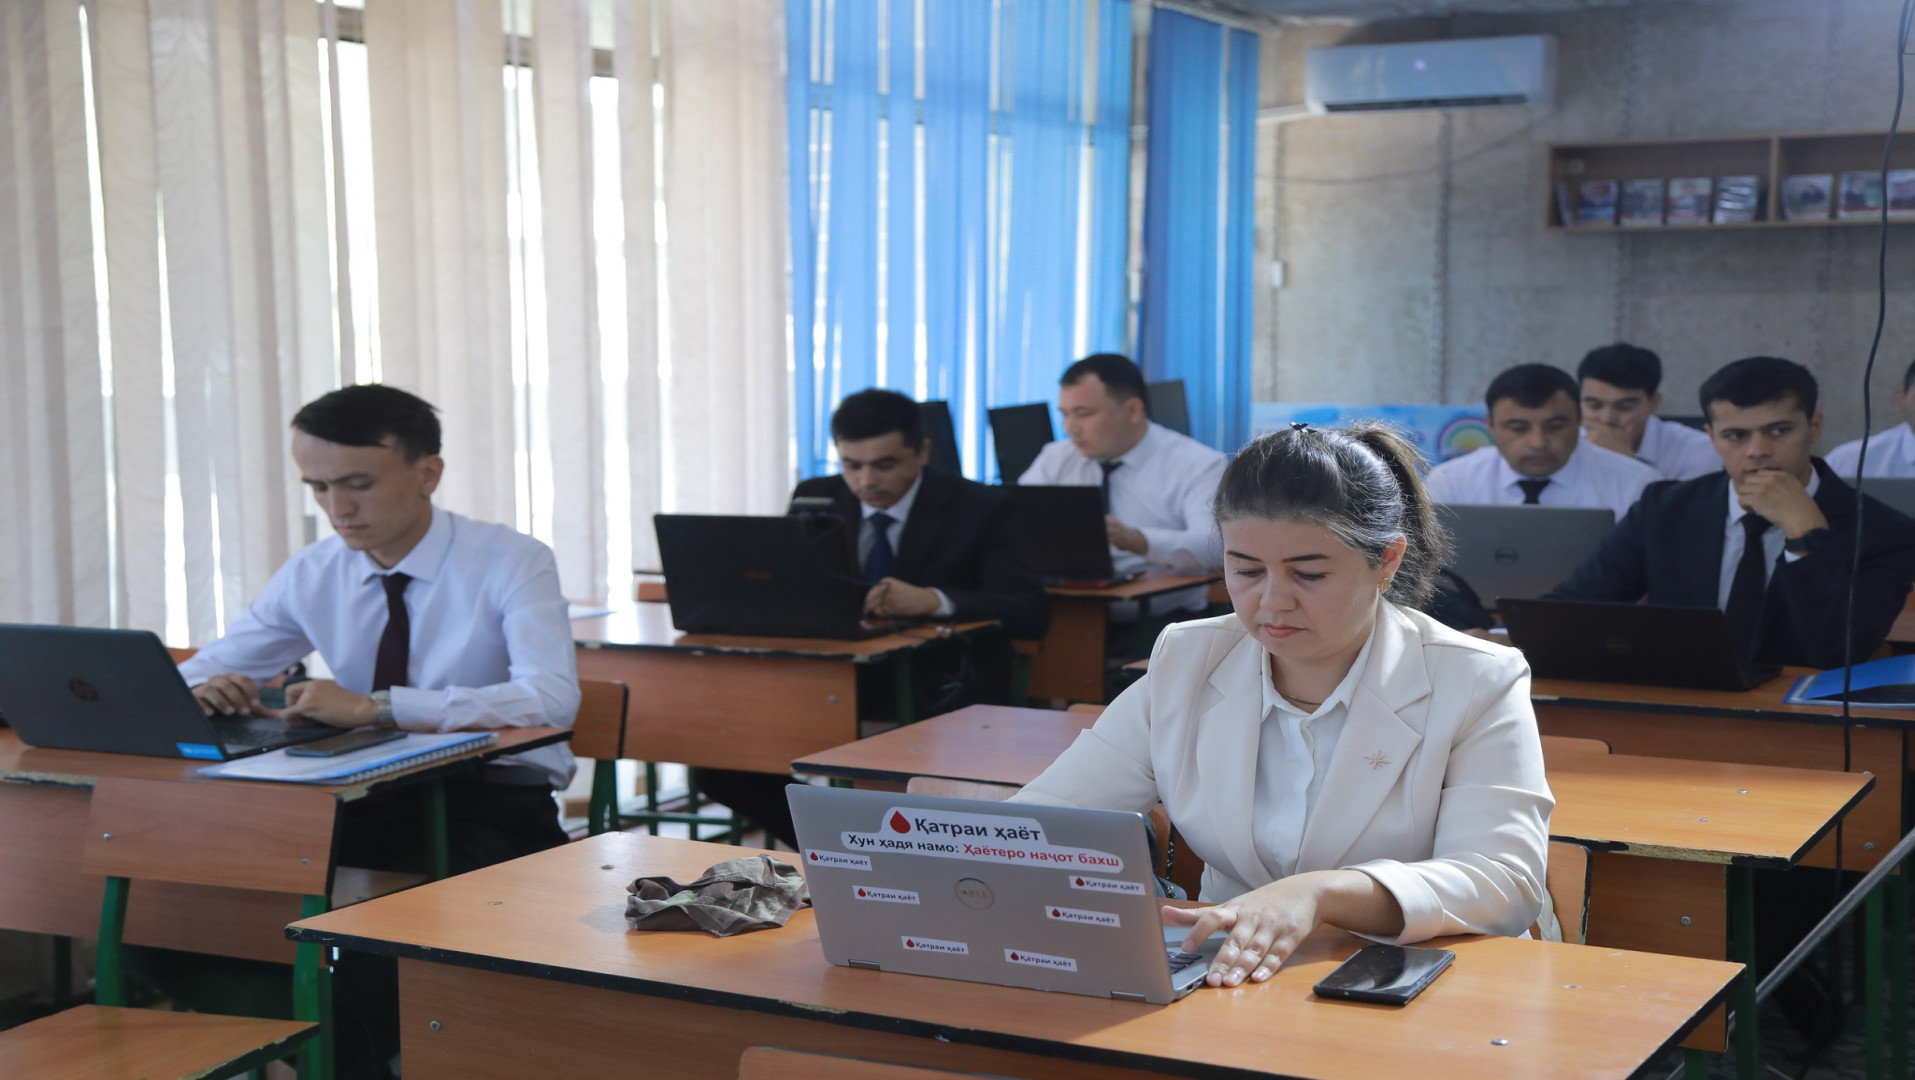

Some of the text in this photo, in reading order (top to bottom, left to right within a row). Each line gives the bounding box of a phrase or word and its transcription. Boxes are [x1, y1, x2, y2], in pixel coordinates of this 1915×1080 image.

[914, 818, 1041, 841] Қатраи ҳаёт
[848, 834, 875, 847] Хун
[879, 839, 913, 850] ҳадя
[917, 843, 959, 853] намо:
[963, 843, 1026, 860] Ҳаётеро
[1078, 852, 1119, 867] бахш
